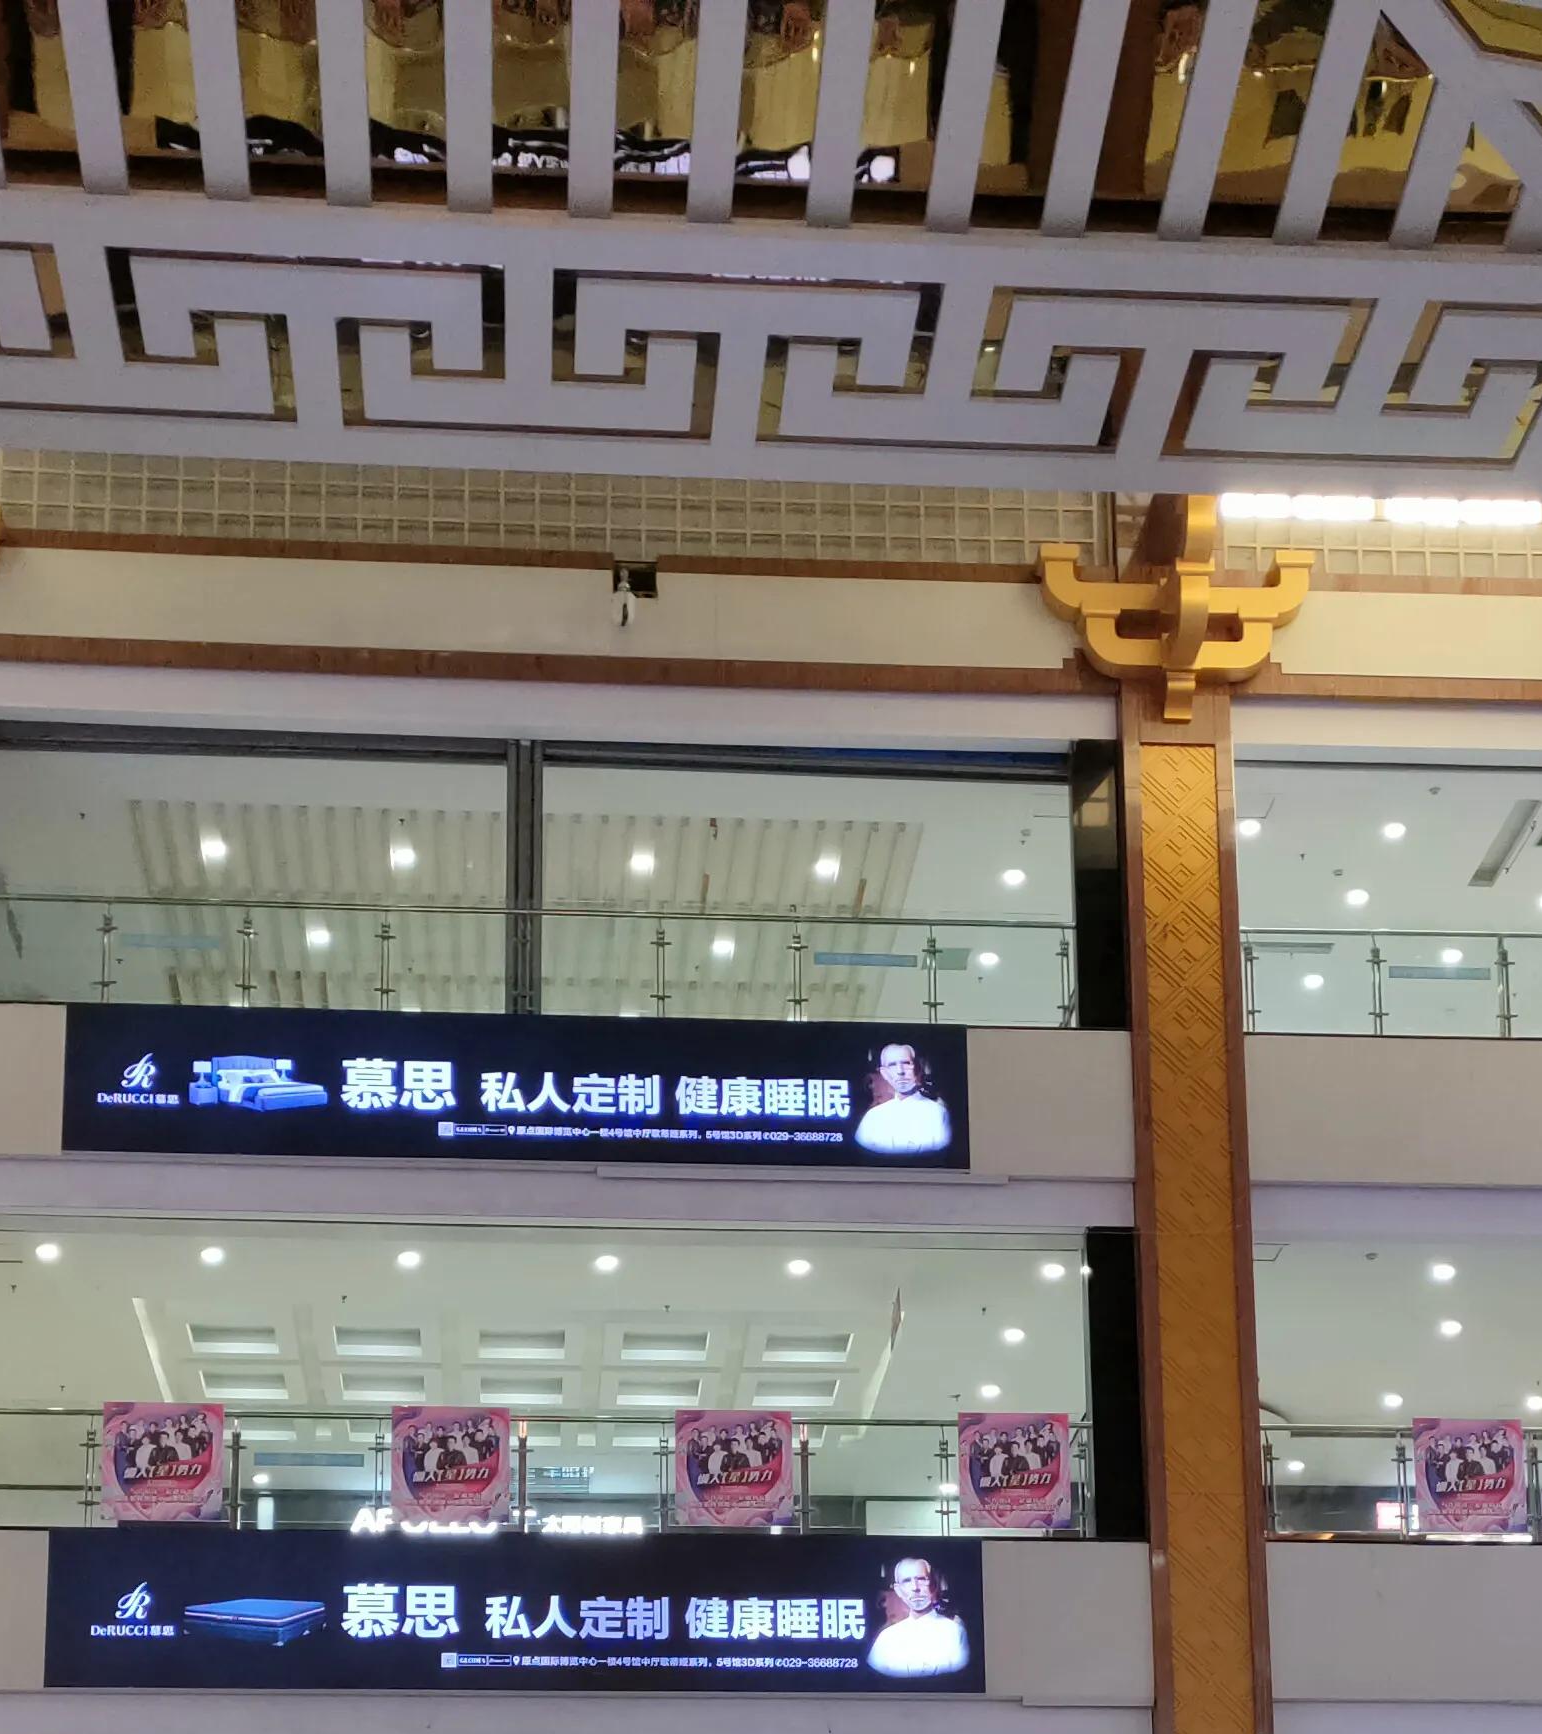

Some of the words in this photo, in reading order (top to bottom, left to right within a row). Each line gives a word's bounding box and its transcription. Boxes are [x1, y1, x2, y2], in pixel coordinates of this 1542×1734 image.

[340, 1058, 456, 1111] 慕思
[480, 1071, 660, 1115] 私人定制
[674, 1074, 850, 1119] 健康睡眠
[340, 1583, 459, 1638] 慕思
[484, 1596, 671, 1640] 私人定制
[685, 1596, 866, 1641] 健康睡眠
